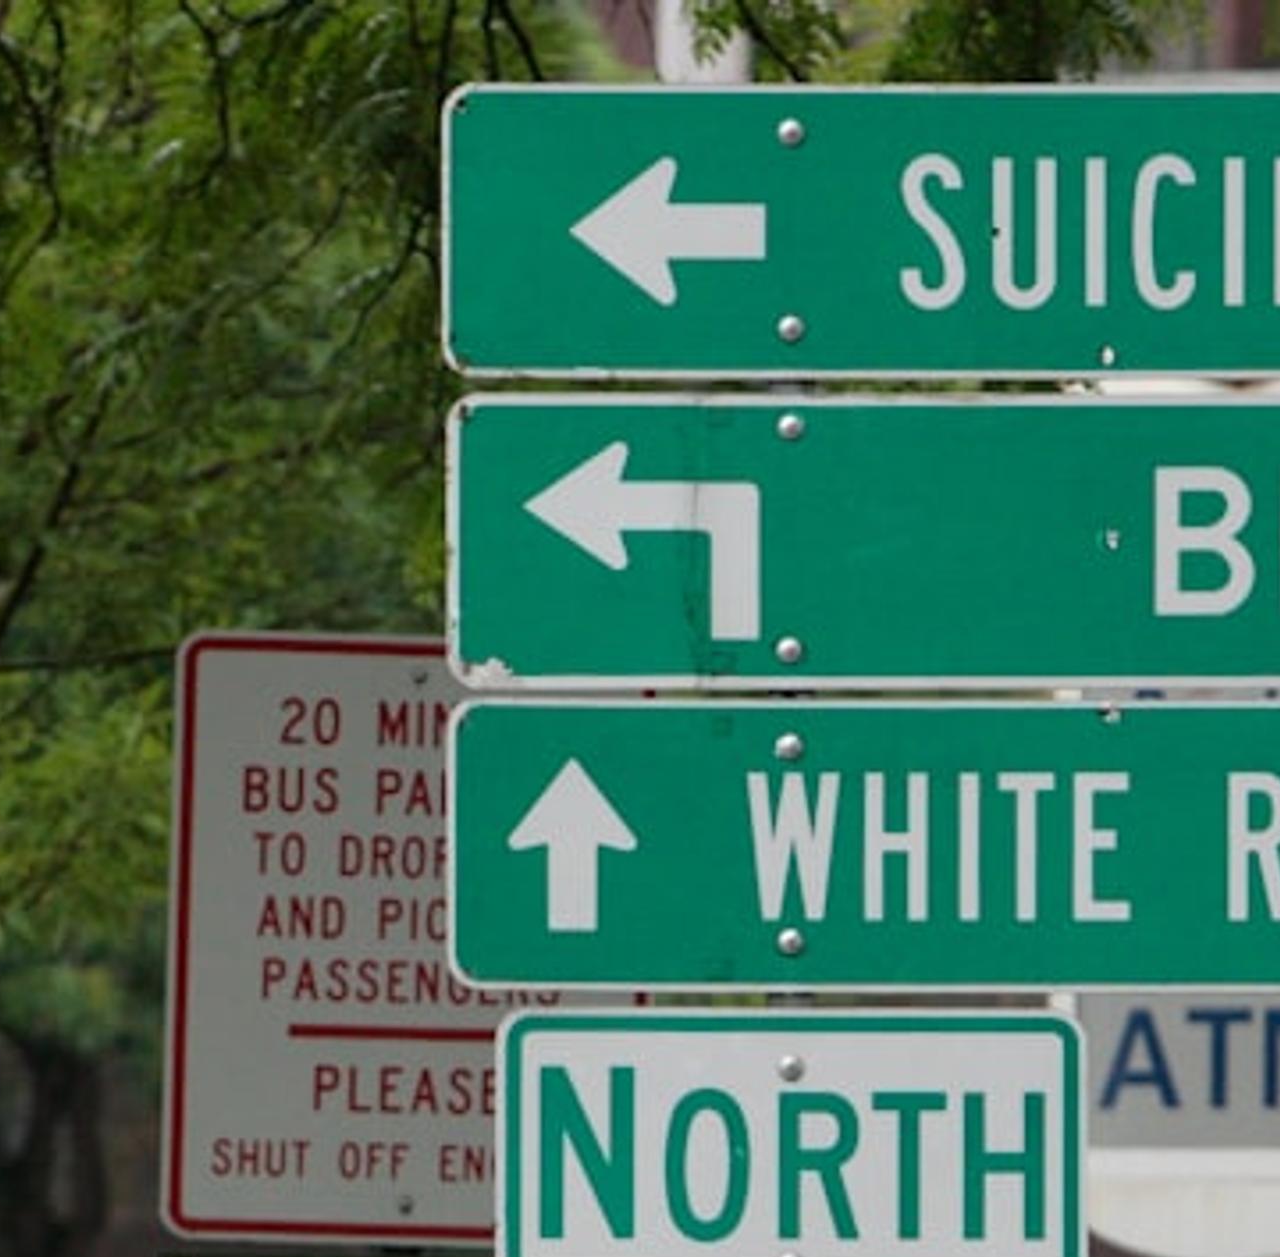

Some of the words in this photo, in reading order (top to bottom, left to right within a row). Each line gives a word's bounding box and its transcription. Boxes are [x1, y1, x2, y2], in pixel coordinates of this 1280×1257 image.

[280, 697, 341, 745] 20
[243, 766, 339, 814] BUS
[376, 768, 447, 816] PA
[254, 832, 306, 876] TO
[746, 771, 1131, 922] WHITE
[257, 896, 344, 940] AND
[313, 1065, 496, 1115] PLEASE
[212, 1139, 310, 1177] SHUT
[339, 1141, 410, 1181] OFF
[439, 1144, 496, 1183] EN
[538, 1064, 1047, 1244] NORTH
